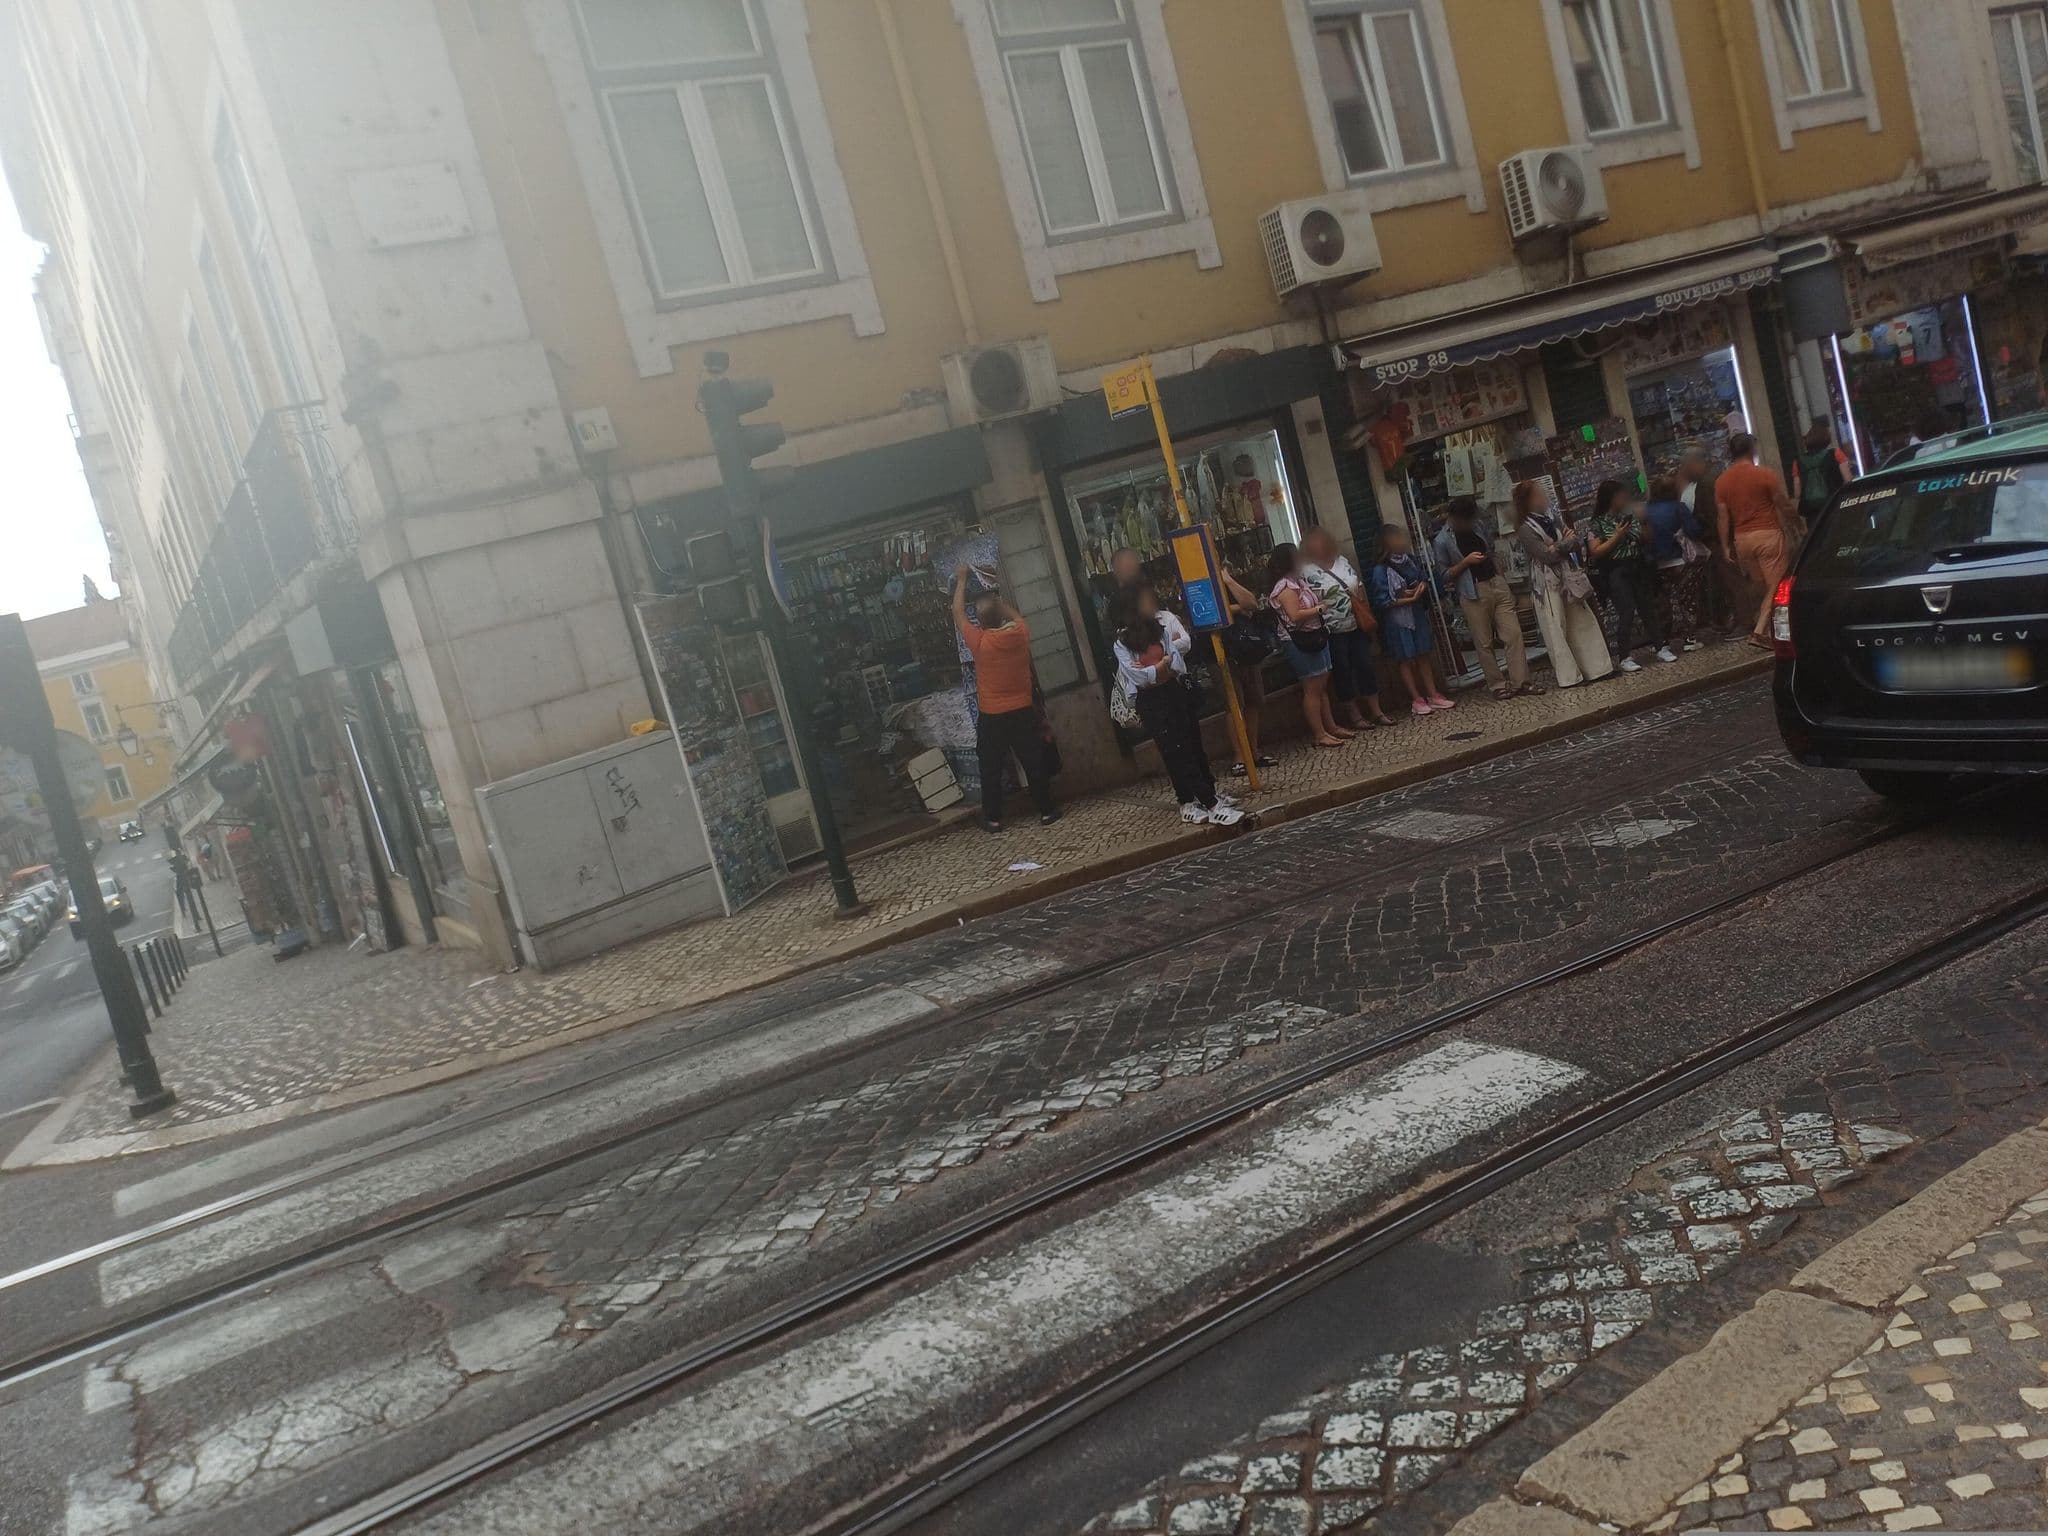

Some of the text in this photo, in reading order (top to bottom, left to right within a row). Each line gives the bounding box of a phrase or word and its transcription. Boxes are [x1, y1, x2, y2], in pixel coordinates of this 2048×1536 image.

[1655, 276, 1734, 308] SOUVENIRS
[1375, 351, 1448, 380] STOP 28
[1856, 630, 2028, 647] LOGAN MCV
